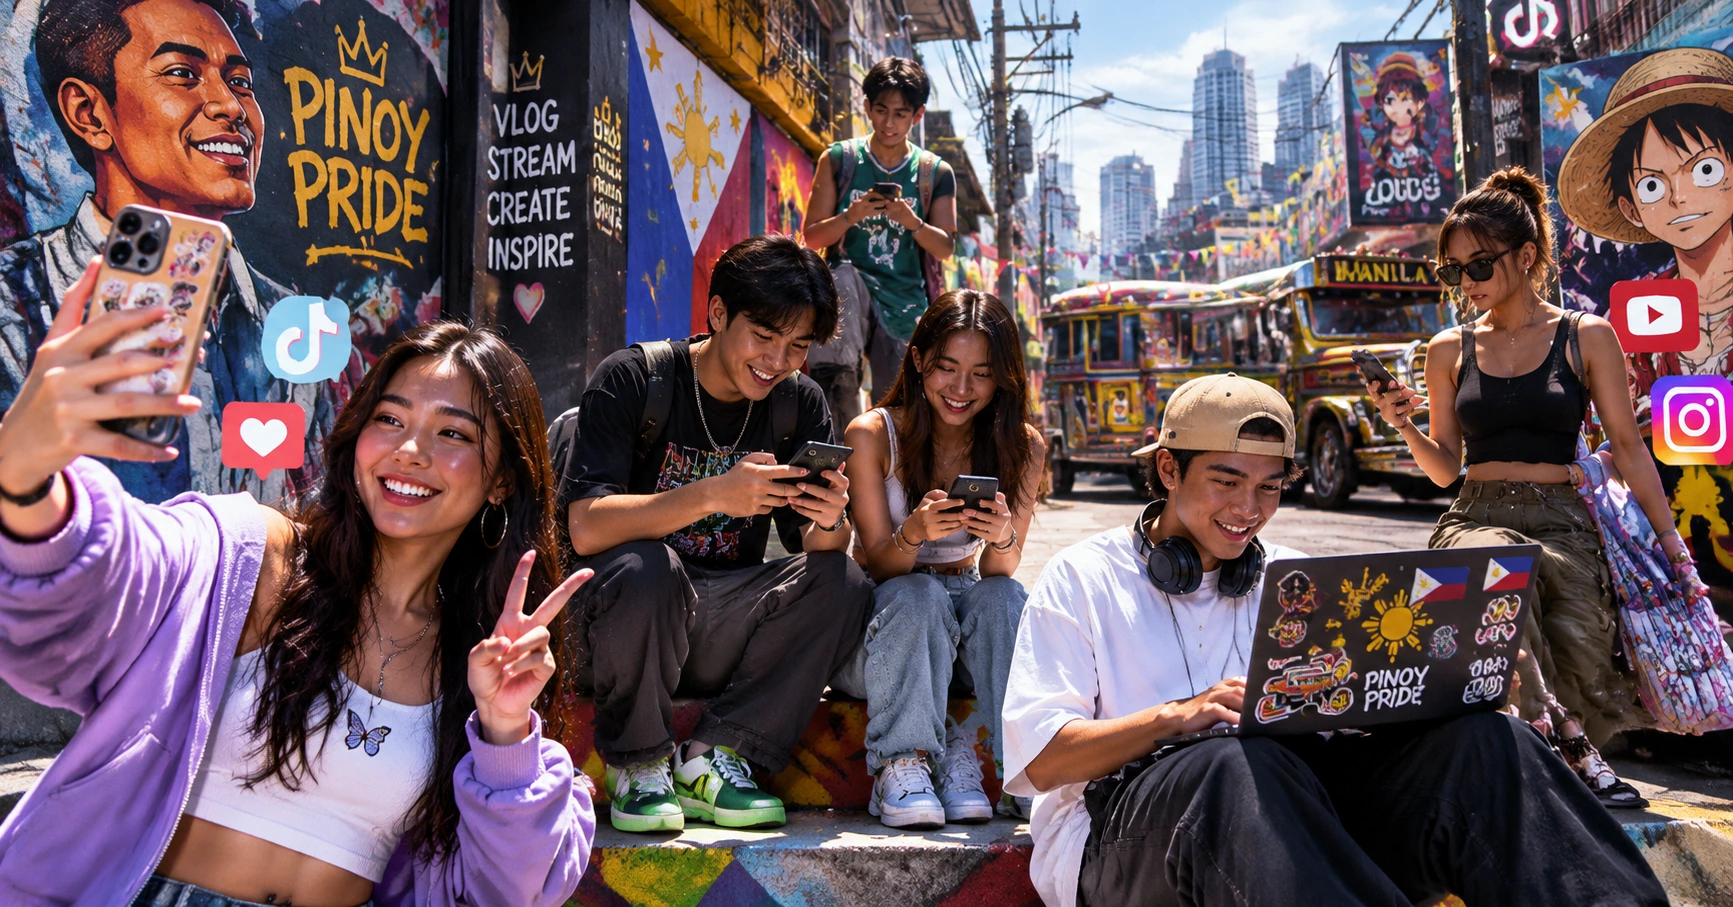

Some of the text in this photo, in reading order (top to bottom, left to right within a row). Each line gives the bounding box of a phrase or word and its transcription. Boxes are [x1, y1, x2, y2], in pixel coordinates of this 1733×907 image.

[283, 65, 430, 174] PINOY
[492, 98, 560, 138] VLOG
[486, 139, 576, 181] STREAM
[287, 149, 429, 243] PRIDE
[486, 186, 571, 226] CREATE
[487, 232, 574, 271] INSPIRE
[1363, 664, 1430, 691] PINOY
[1363, 684, 1426, 712] PRIDE
